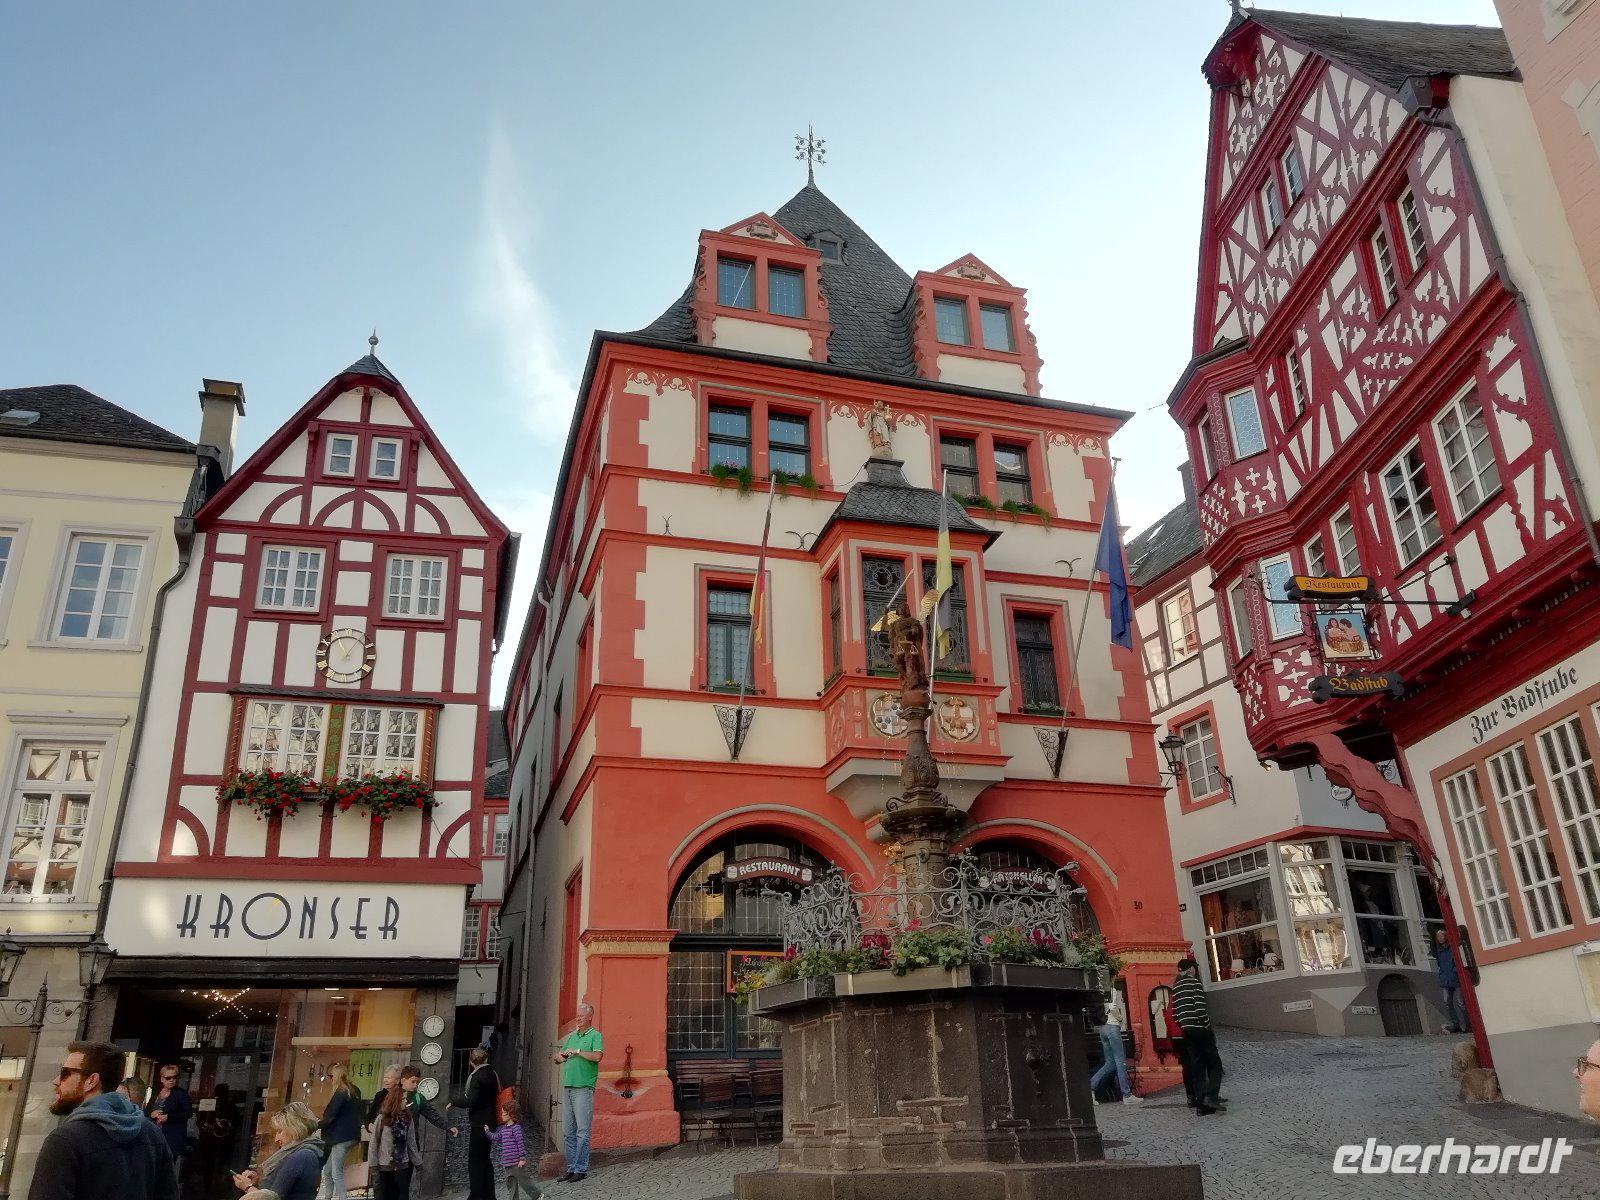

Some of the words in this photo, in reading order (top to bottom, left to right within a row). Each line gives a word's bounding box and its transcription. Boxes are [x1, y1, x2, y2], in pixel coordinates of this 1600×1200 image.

[1304, 578, 1361, 589] Restaurant
[1470, 709, 1499, 744] Zur
[739, 861, 801, 876] RESTAURANT
[177, 892, 400, 940] KRONSER
